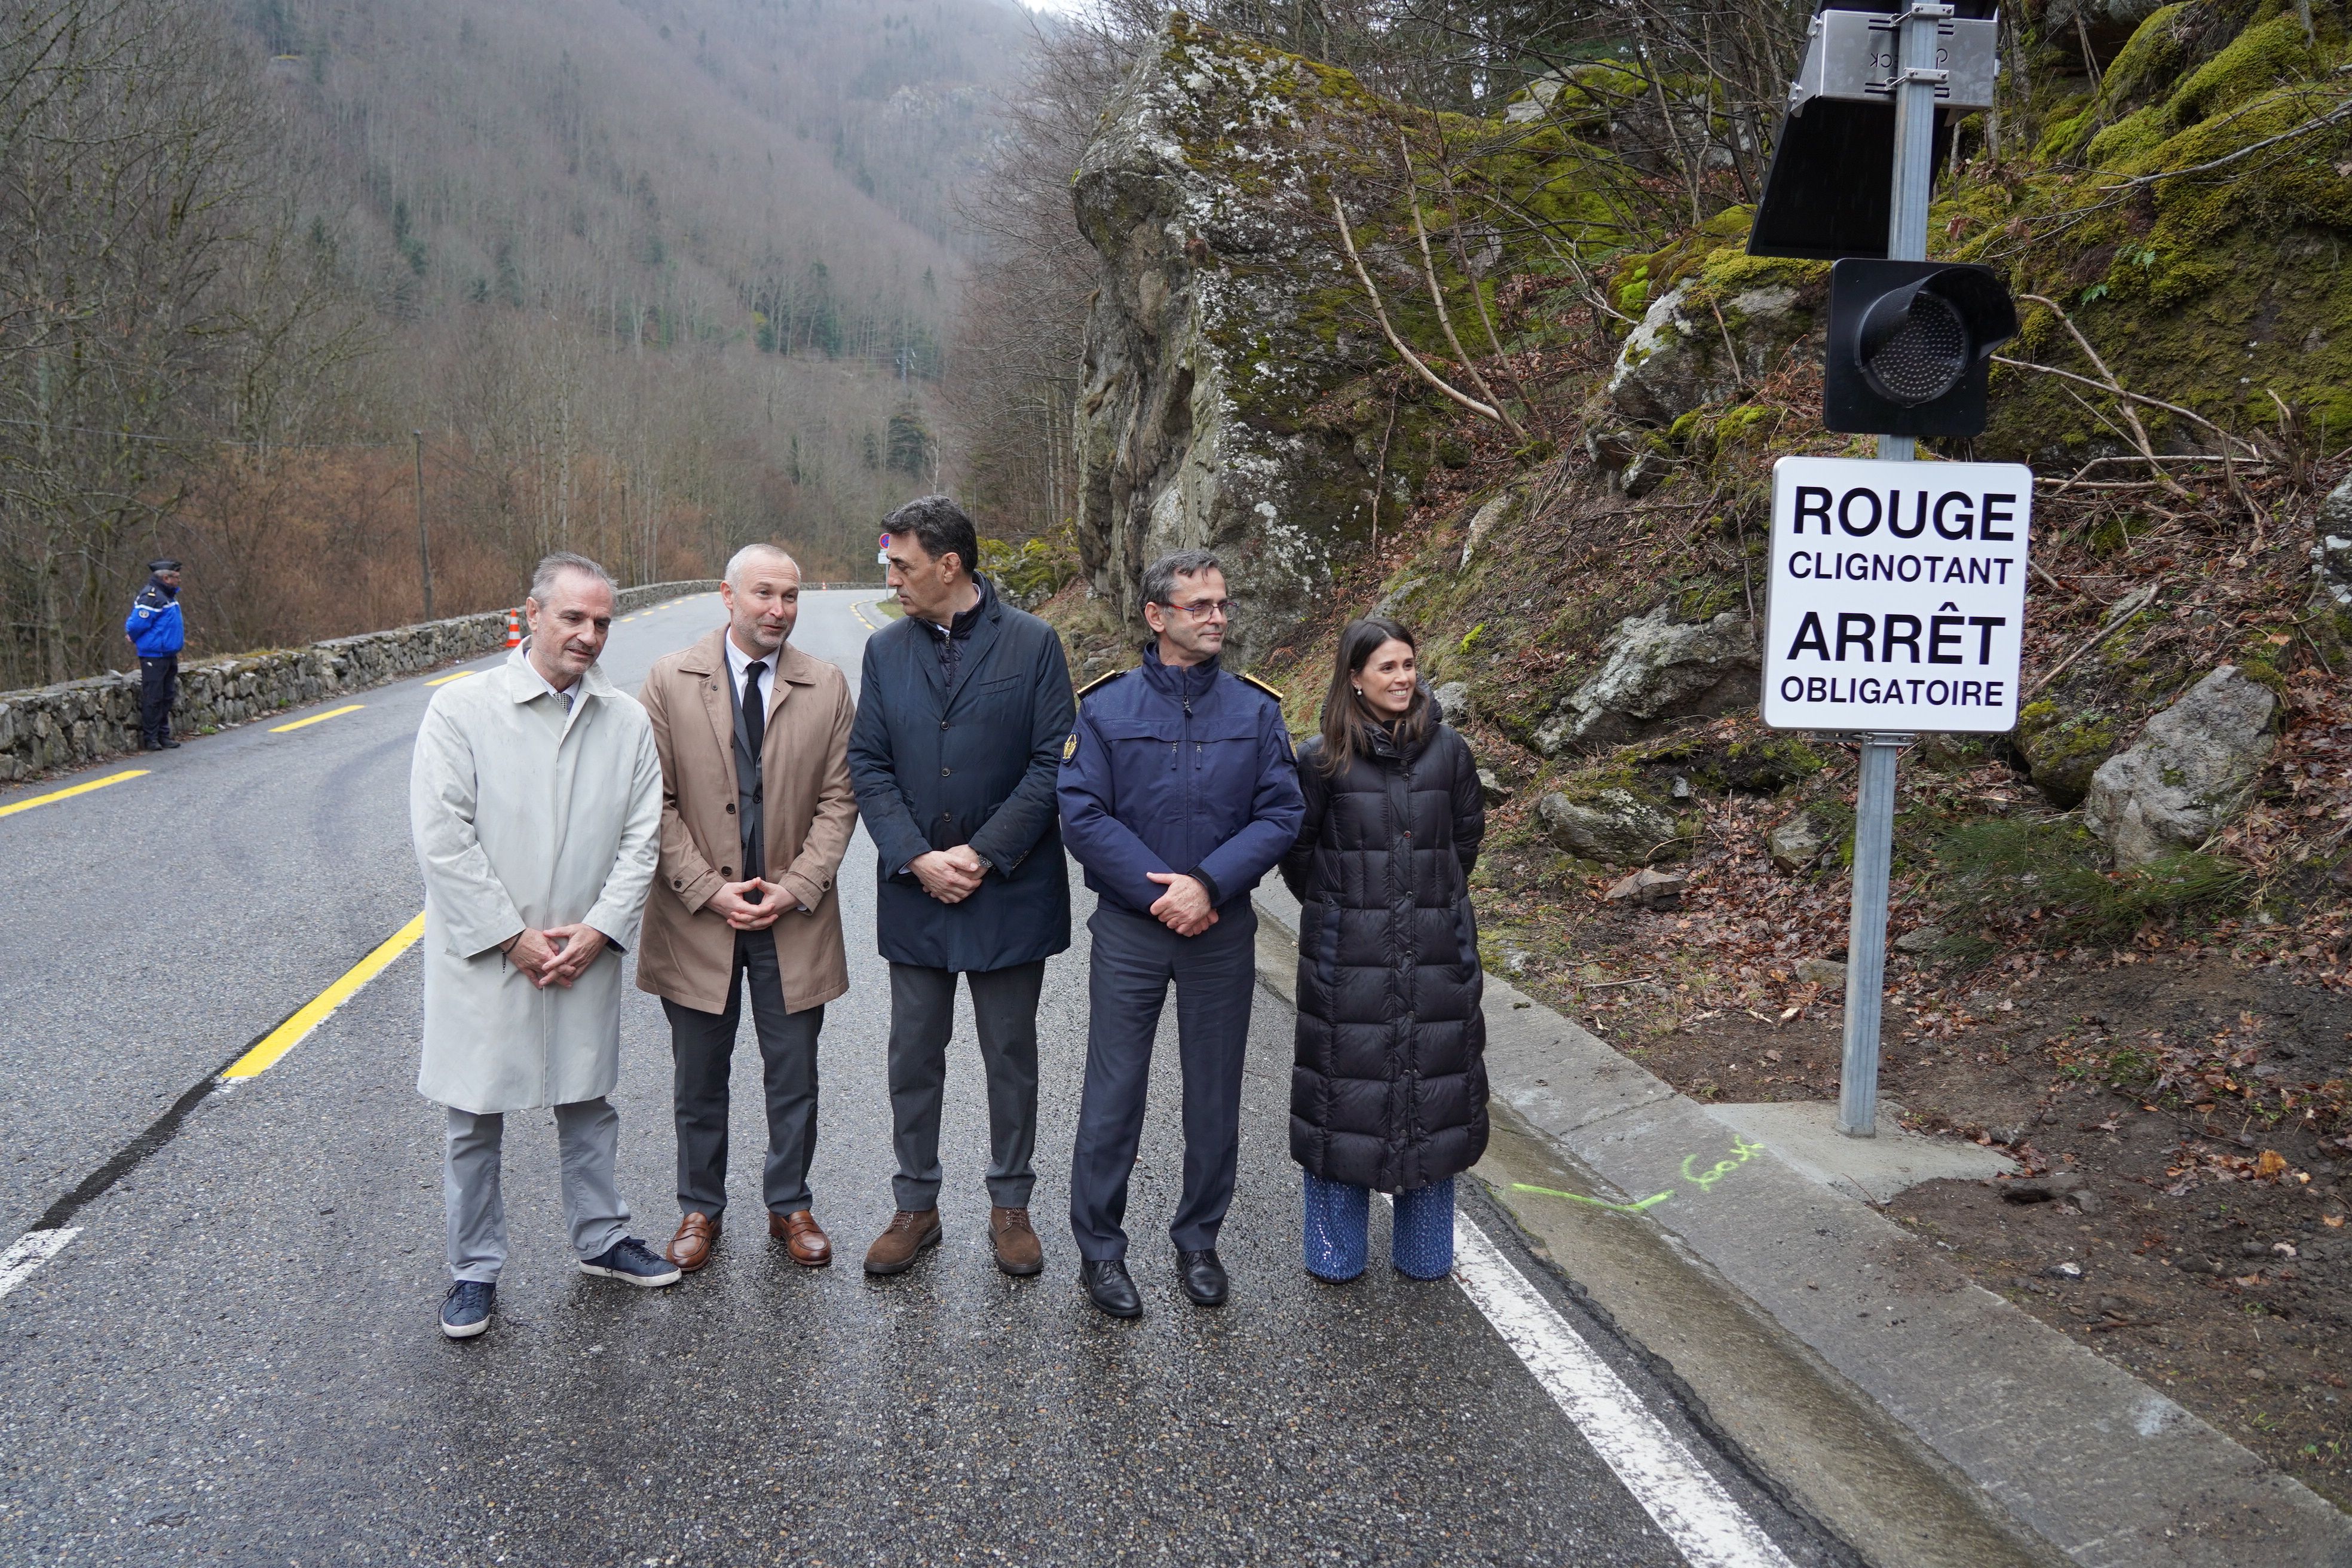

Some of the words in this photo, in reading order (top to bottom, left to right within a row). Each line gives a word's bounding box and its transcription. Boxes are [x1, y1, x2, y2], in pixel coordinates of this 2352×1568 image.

[1793, 486, 2016, 541] ROUGE
[1788, 551, 2014, 584] CLIGNOTANT
[1786, 601, 2006, 665] ARRÊT
[1781, 676, 2004, 706] OBLIGATOIRE
